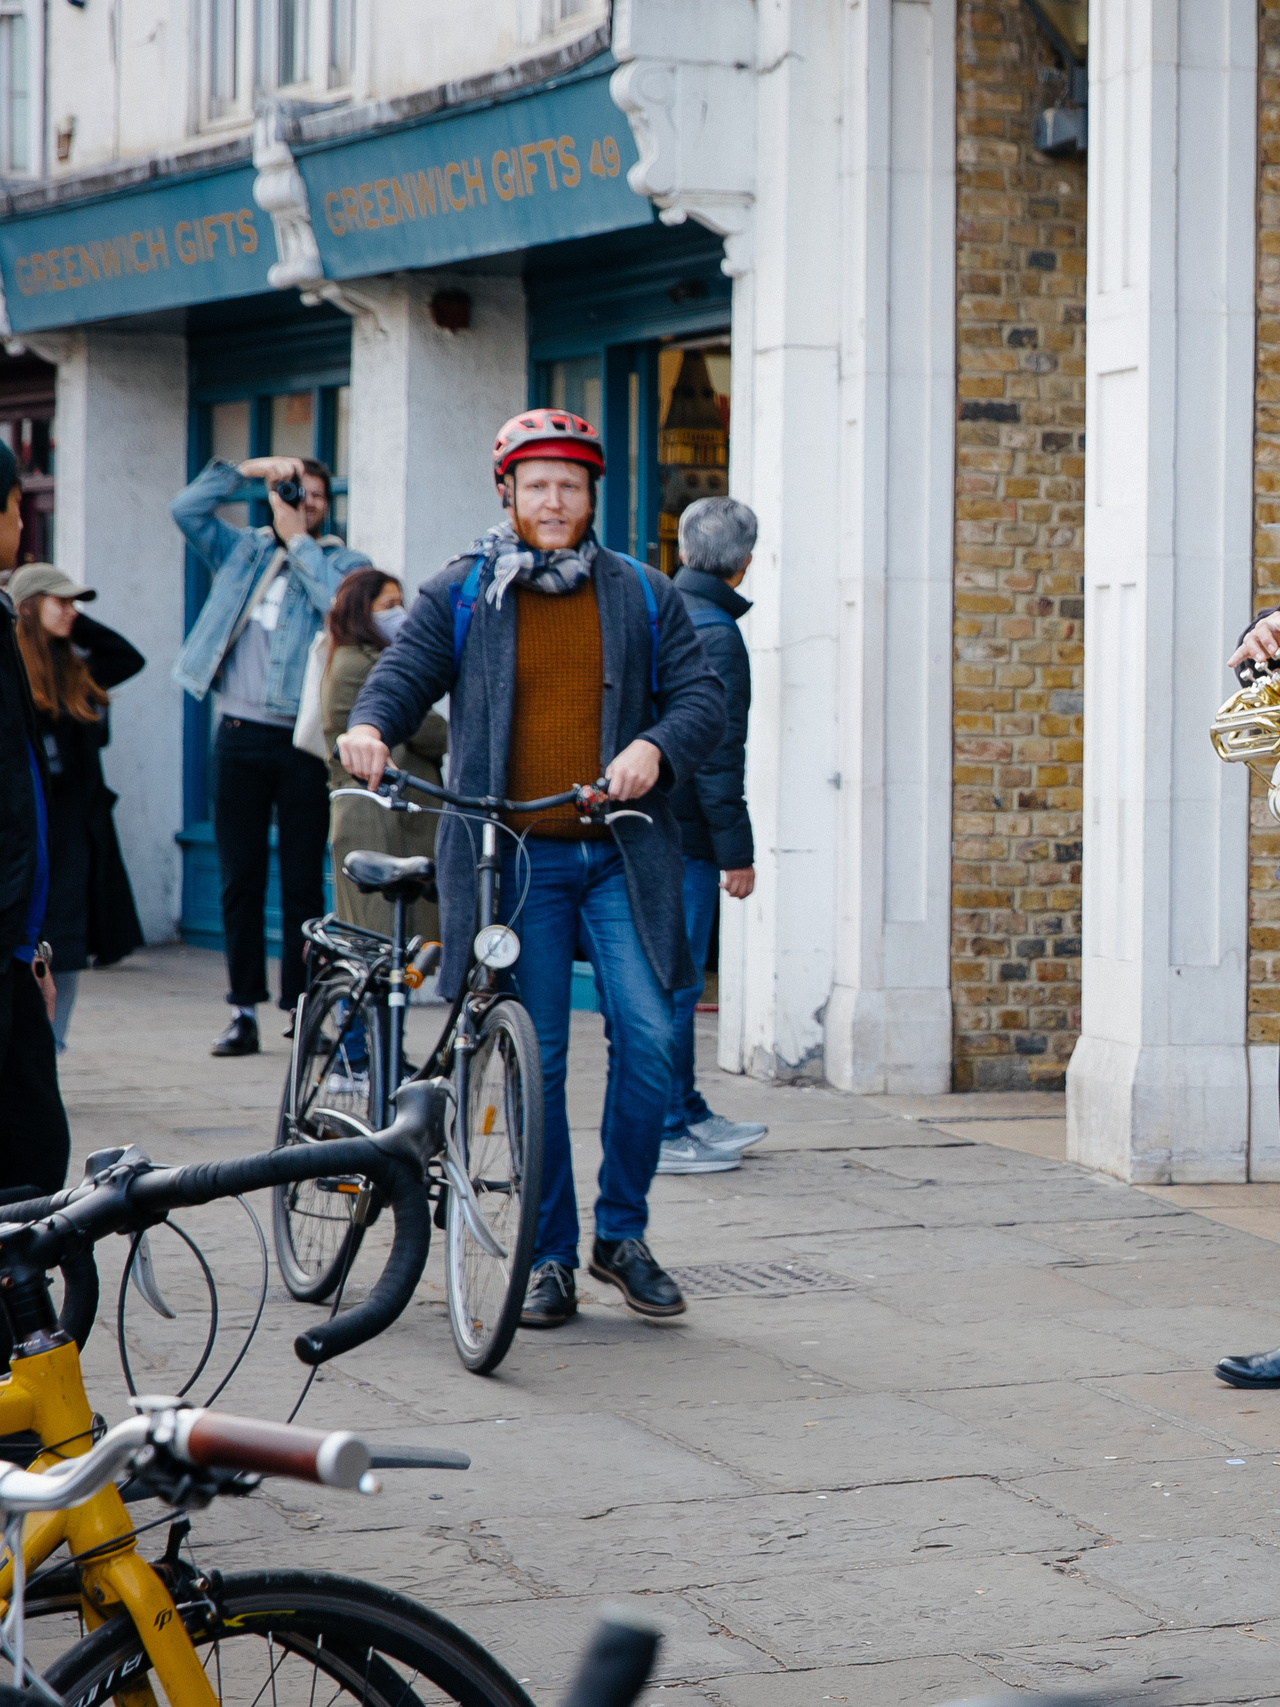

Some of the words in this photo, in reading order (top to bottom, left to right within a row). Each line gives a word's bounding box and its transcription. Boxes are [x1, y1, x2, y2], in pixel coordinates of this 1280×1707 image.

[323, 157, 488, 237] GREENWICH
[491, 135, 582, 202] GIFTS
[589, 136, 621, 179] 49
[14, 226, 170, 298] GREENWICH
[174, 208, 259, 266] GIFTS
